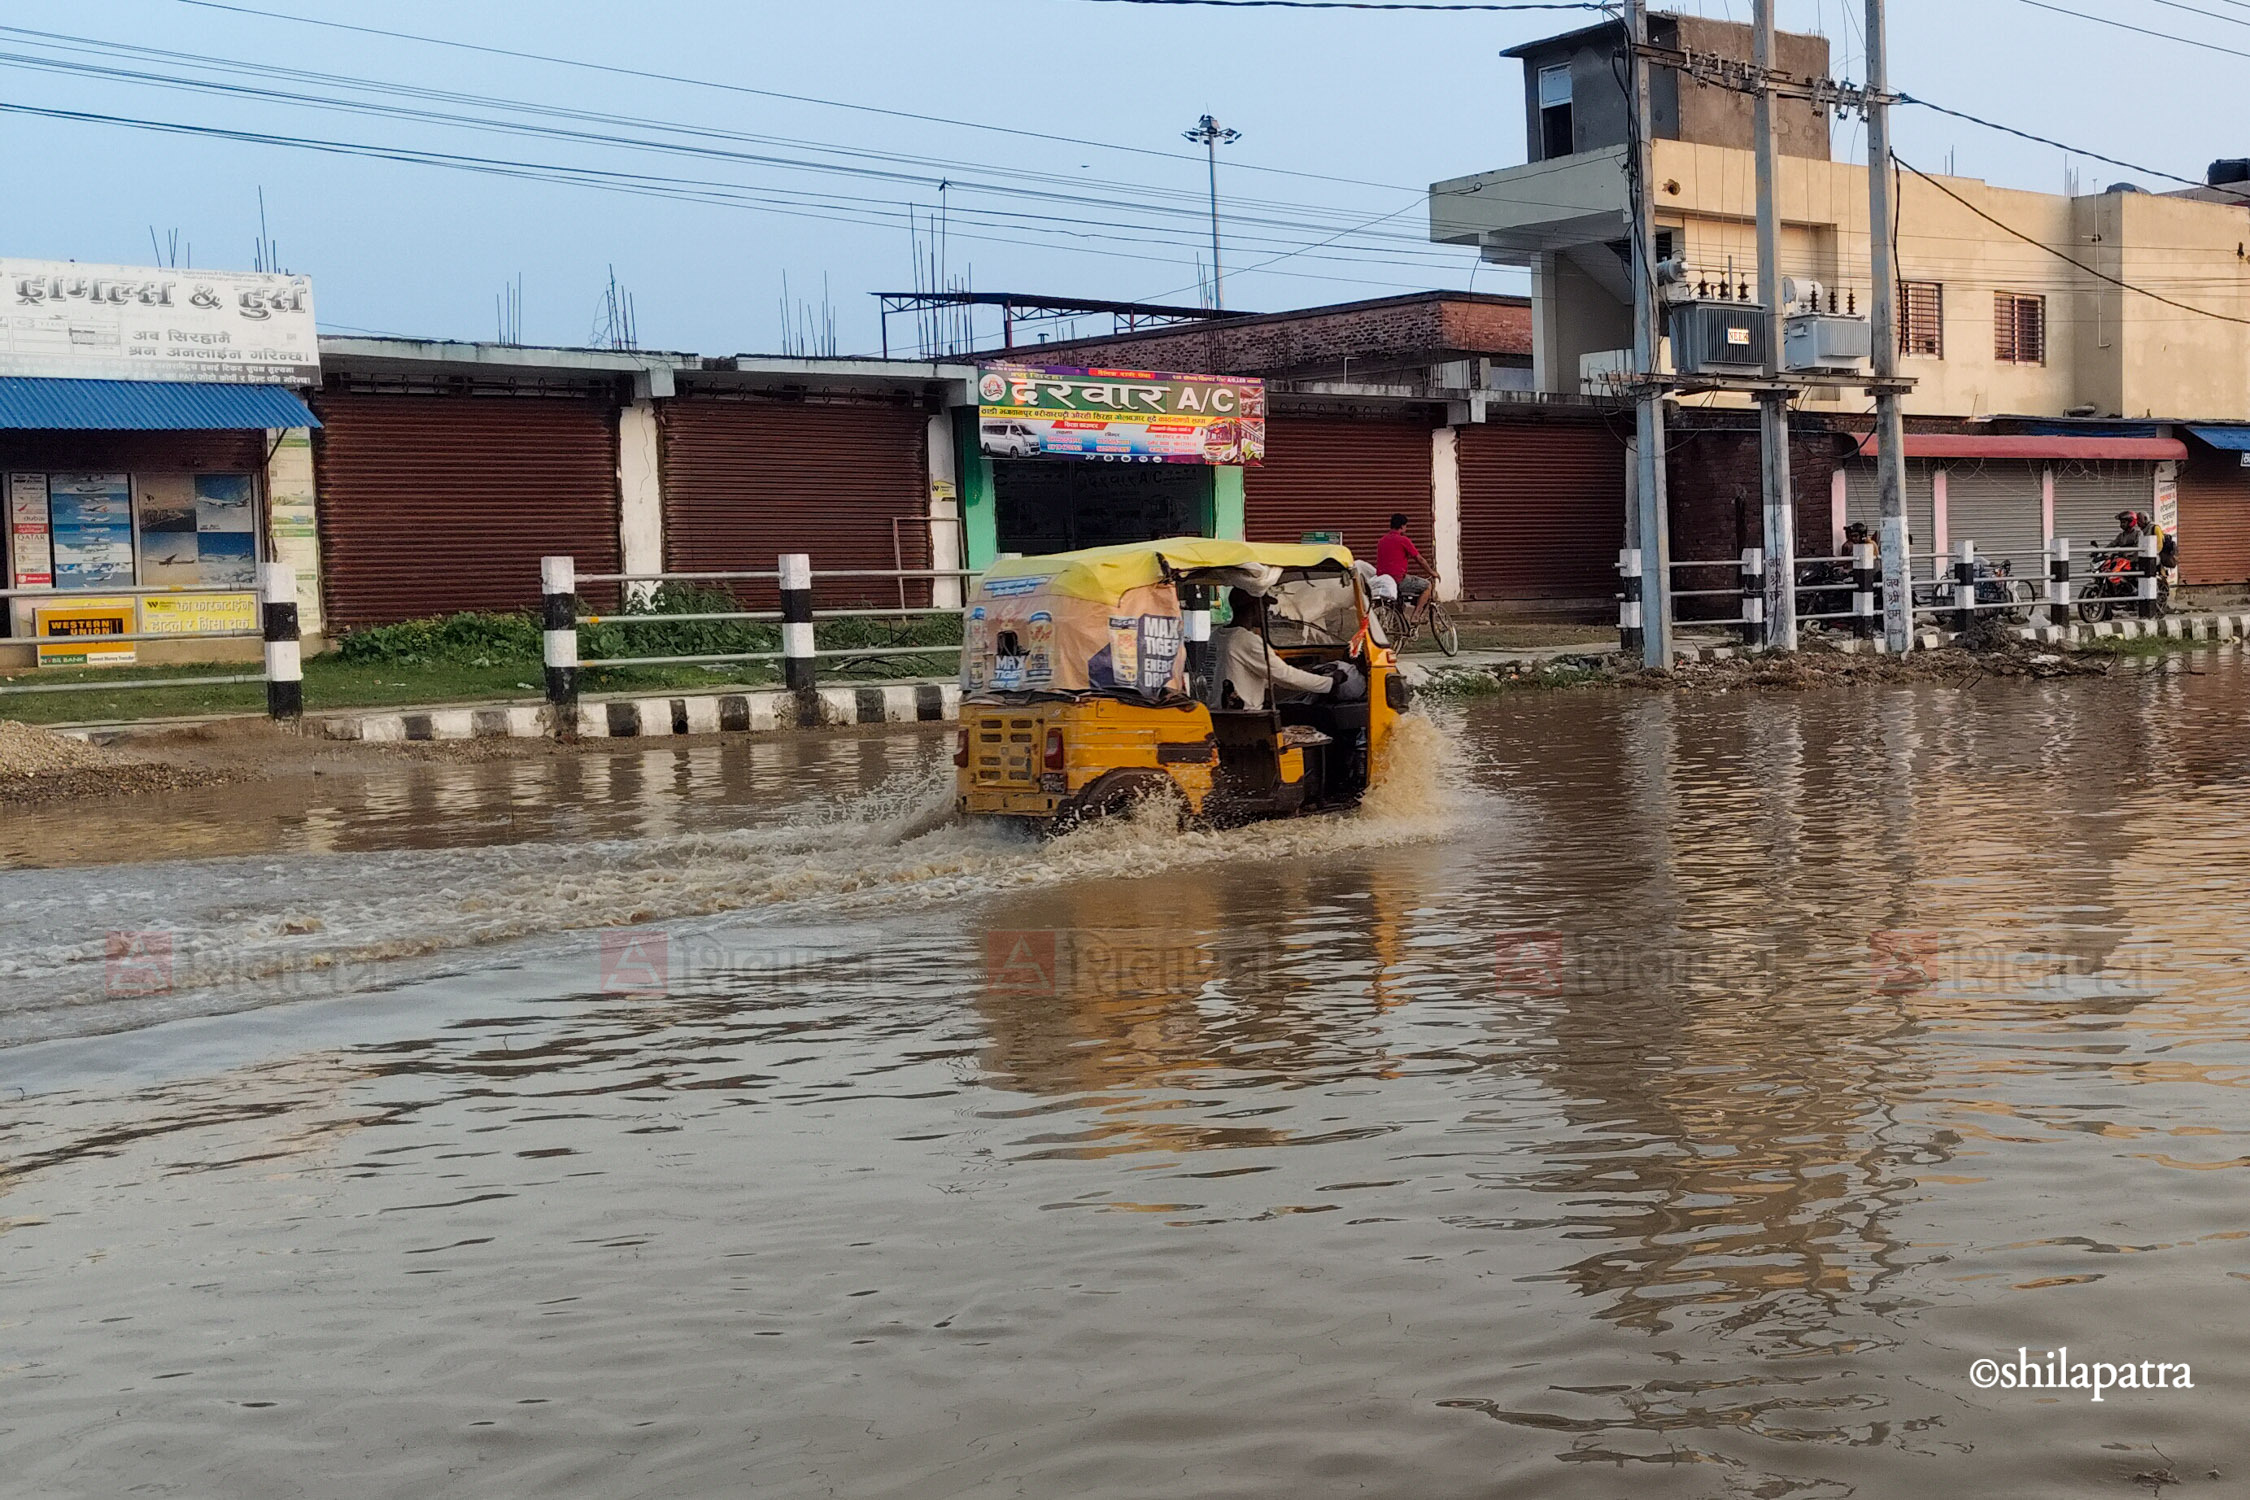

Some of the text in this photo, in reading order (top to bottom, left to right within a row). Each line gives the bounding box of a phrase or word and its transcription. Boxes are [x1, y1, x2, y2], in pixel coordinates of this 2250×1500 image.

[189, 283, 223, 310] &
[132, 330, 160, 341] अब
[1177, 387, 1234, 413] A/C
[51, 620, 110, 629] WESTERN
[69, 627, 110, 635] UNION
[1144, 616, 1179, 639] MAX
[996, 655, 1026, 669] MAX
